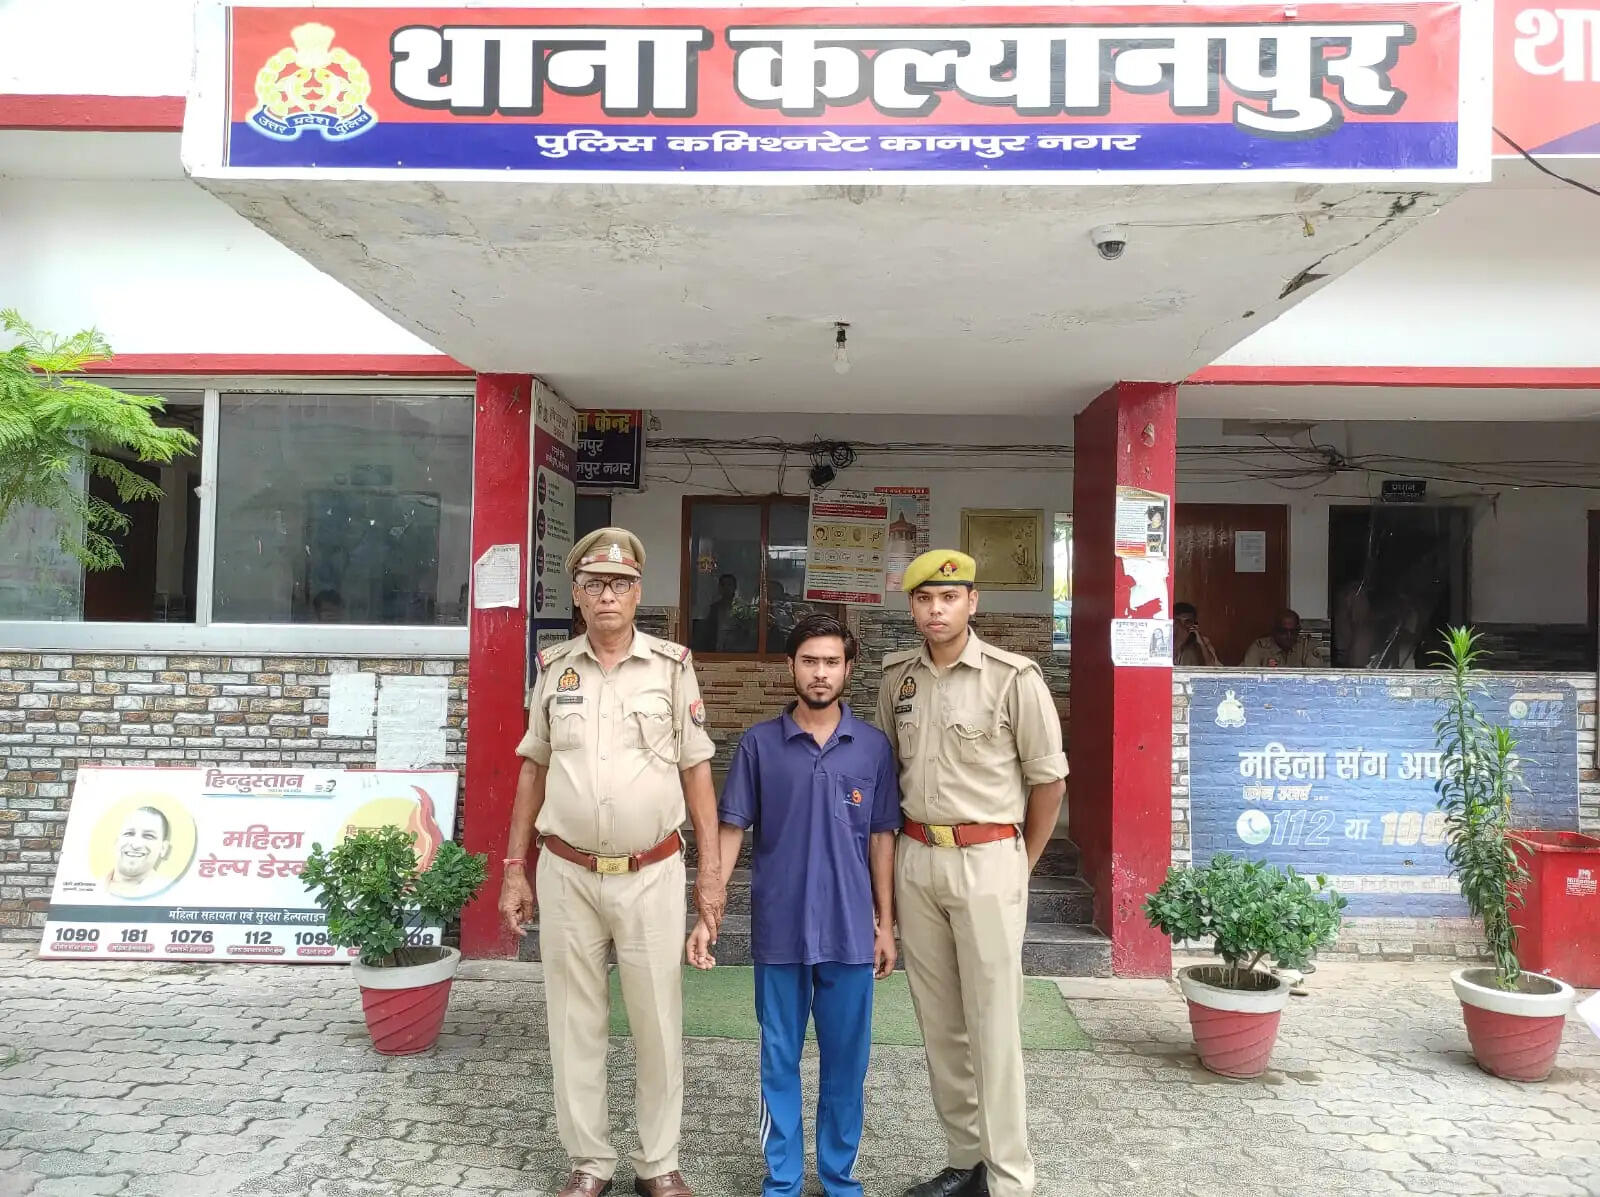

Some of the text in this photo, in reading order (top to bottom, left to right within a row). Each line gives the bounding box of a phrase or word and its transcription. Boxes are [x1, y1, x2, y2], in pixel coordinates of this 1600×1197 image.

[390, 22, 1416, 140] थाना कल्यानपुर
[257, 112, 370, 136] उत्तर प्रदेश पुलिस
[534, 129, 1142, 159] पुलिस कमिश्नरेट कानपुर नगर
[603, 463, 632, 476] नगर
[1528, 700, 1564, 720] 112
[1238, 741, 1328, 781] महिला
[1335, 746, 1389, 780] संग
[205, 768, 304, 793] हिन्दुस्तान
[222, 824, 305, 850] महिला
[1271, 809, 1461, 847] 112 या 109
[198, 852, 252, 878] हेल्प
[168, 907, 326, 925] महिला सहायता एवं सुरक्षा हेल्पलाइन
[55, 927, 100, 942] 1090
[121, 929, 148, 943] 181
[170, 929, 214, 944] 1076
[244, 931, 273, 945] 112
[294, 931, 331, 946] 109
